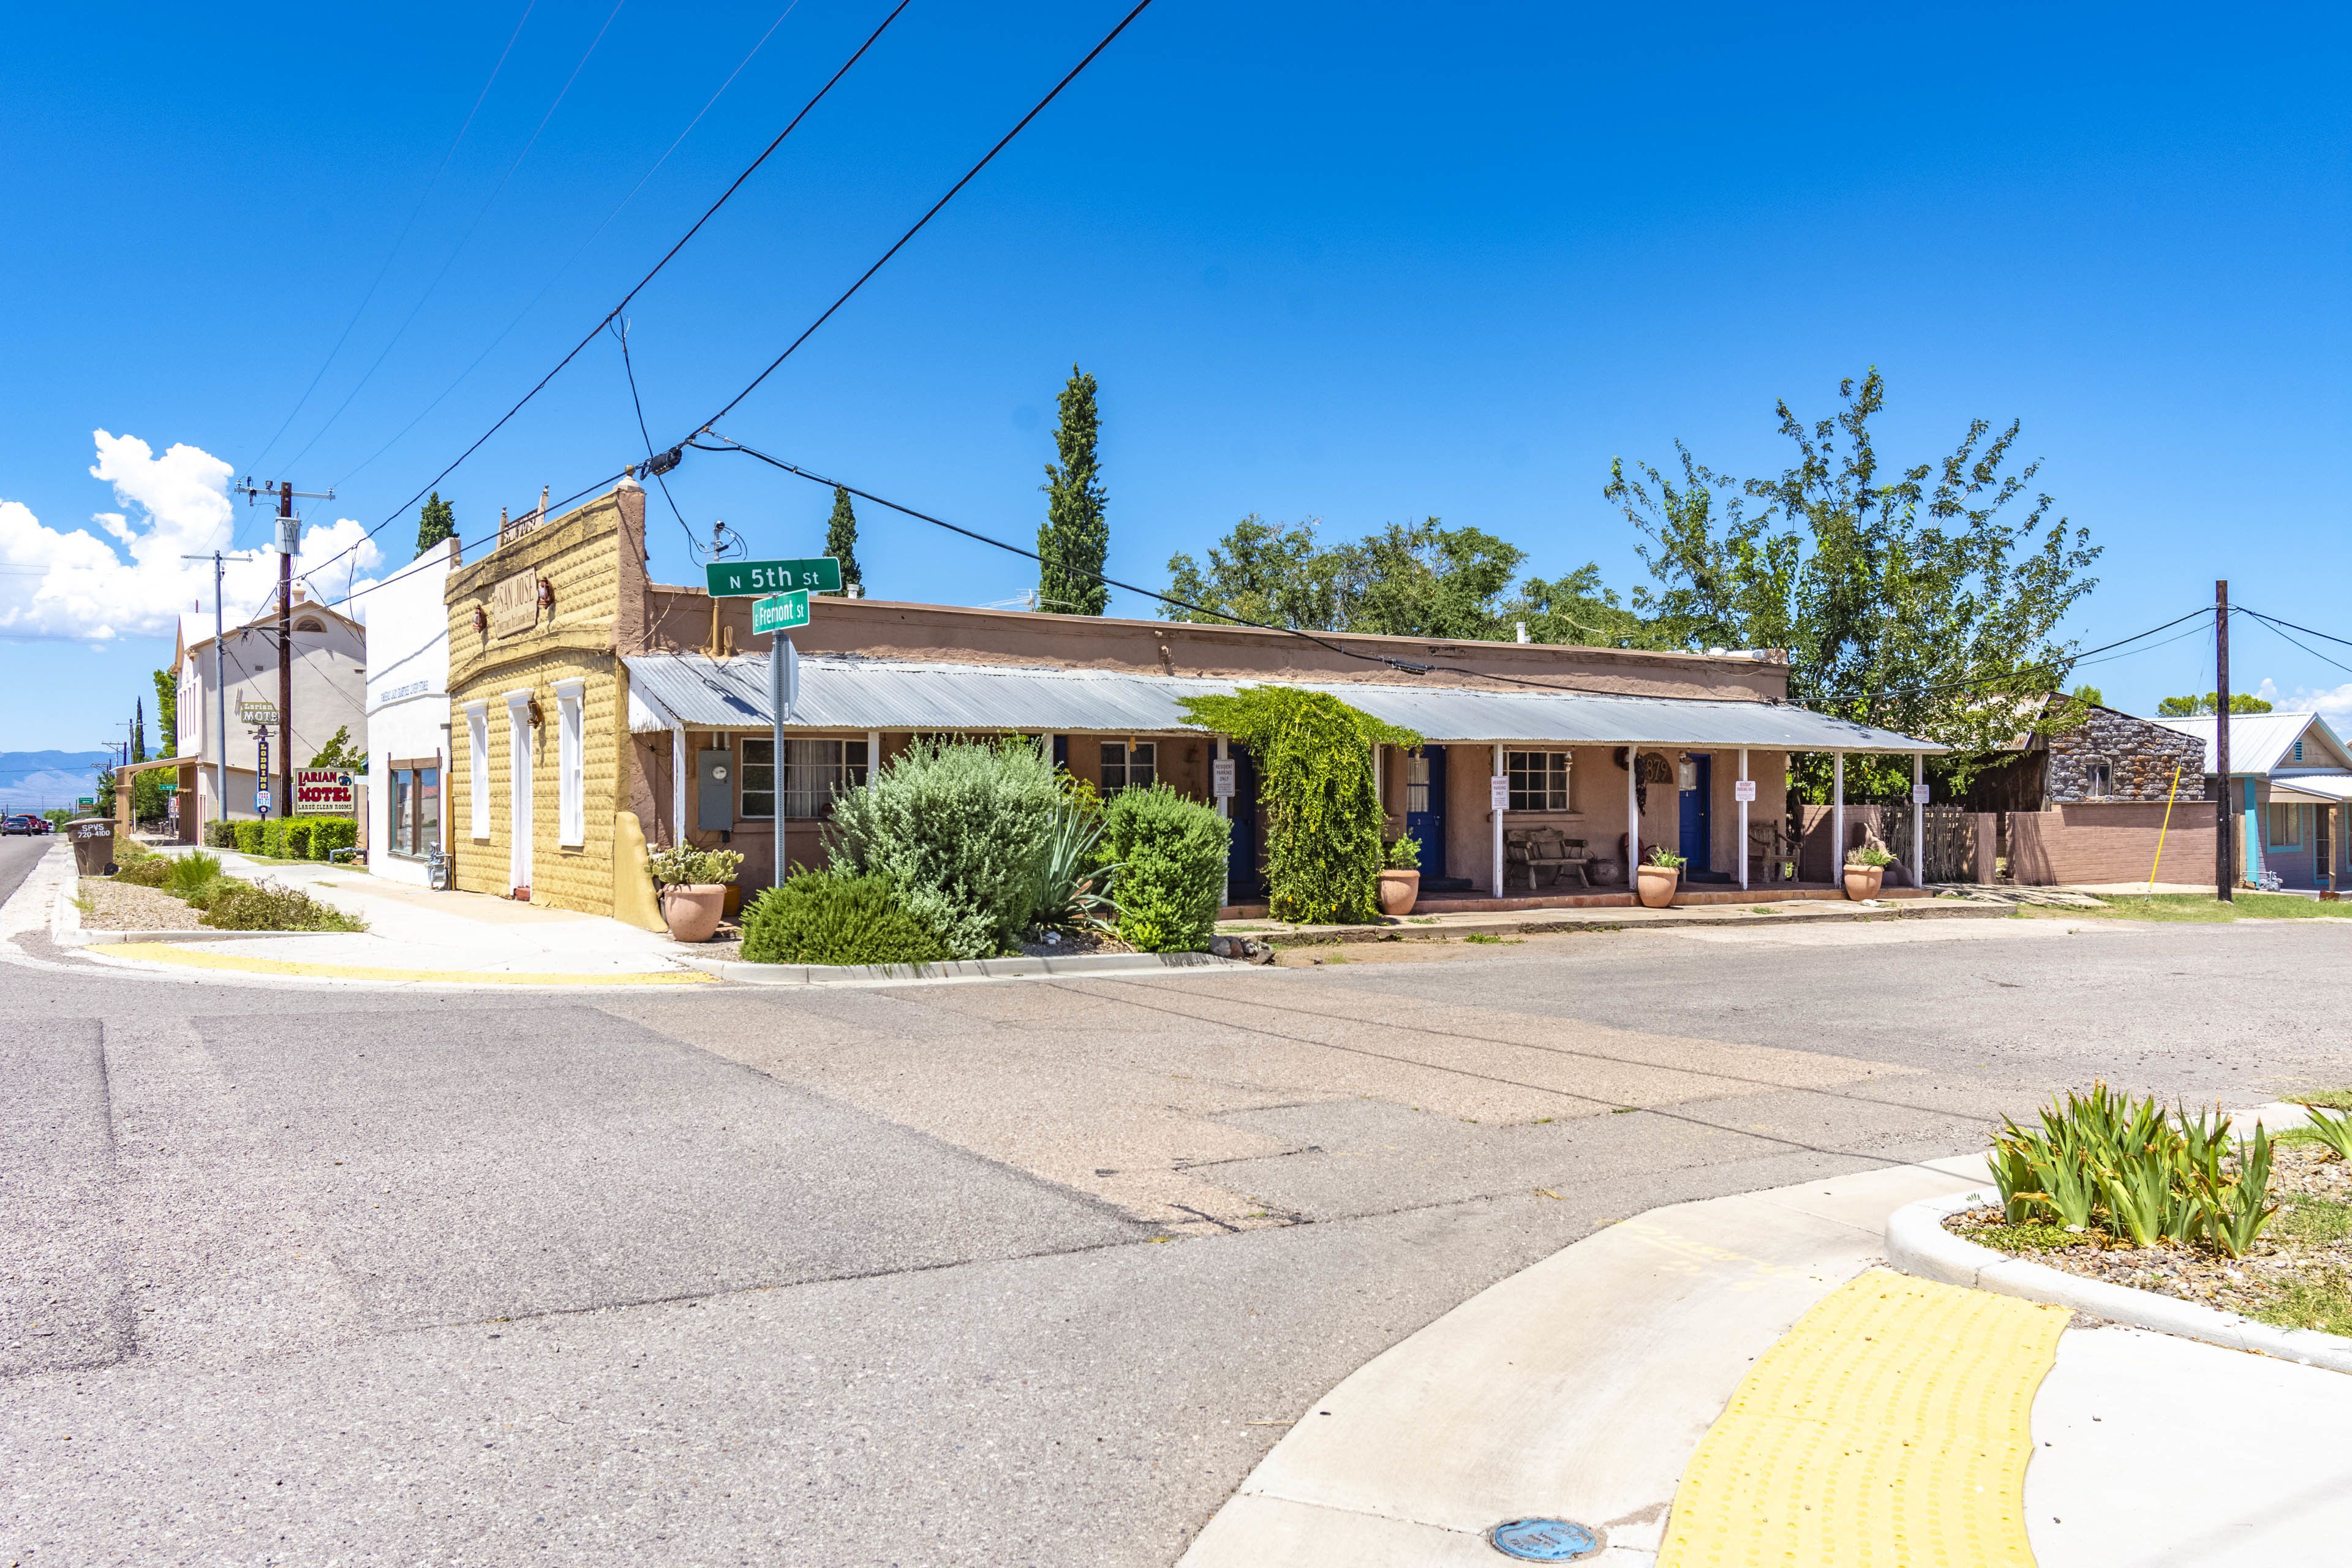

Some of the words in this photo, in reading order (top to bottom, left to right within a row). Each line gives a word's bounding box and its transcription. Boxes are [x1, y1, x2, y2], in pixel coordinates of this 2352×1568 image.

[730, 576, 741, 589] N
[752, 567, 792, 588] 5th
[803, 571, 819, 586] St
[499, 581, 513, 614] SAN
[515, 573, 534, 608] JOSE
[755, 614, 759, 627] E
[760, 600, 794, 625] Fremont
[797, 603, 804, 618] St
[298, 772, 337, 786] LARIAN
[1646, 760, 1667, 781] 879
[298, 787, 352, 802] MOTEL
[78, 830, 111, 839] 720-4100
[82, 823, 105, 832] SPVS
